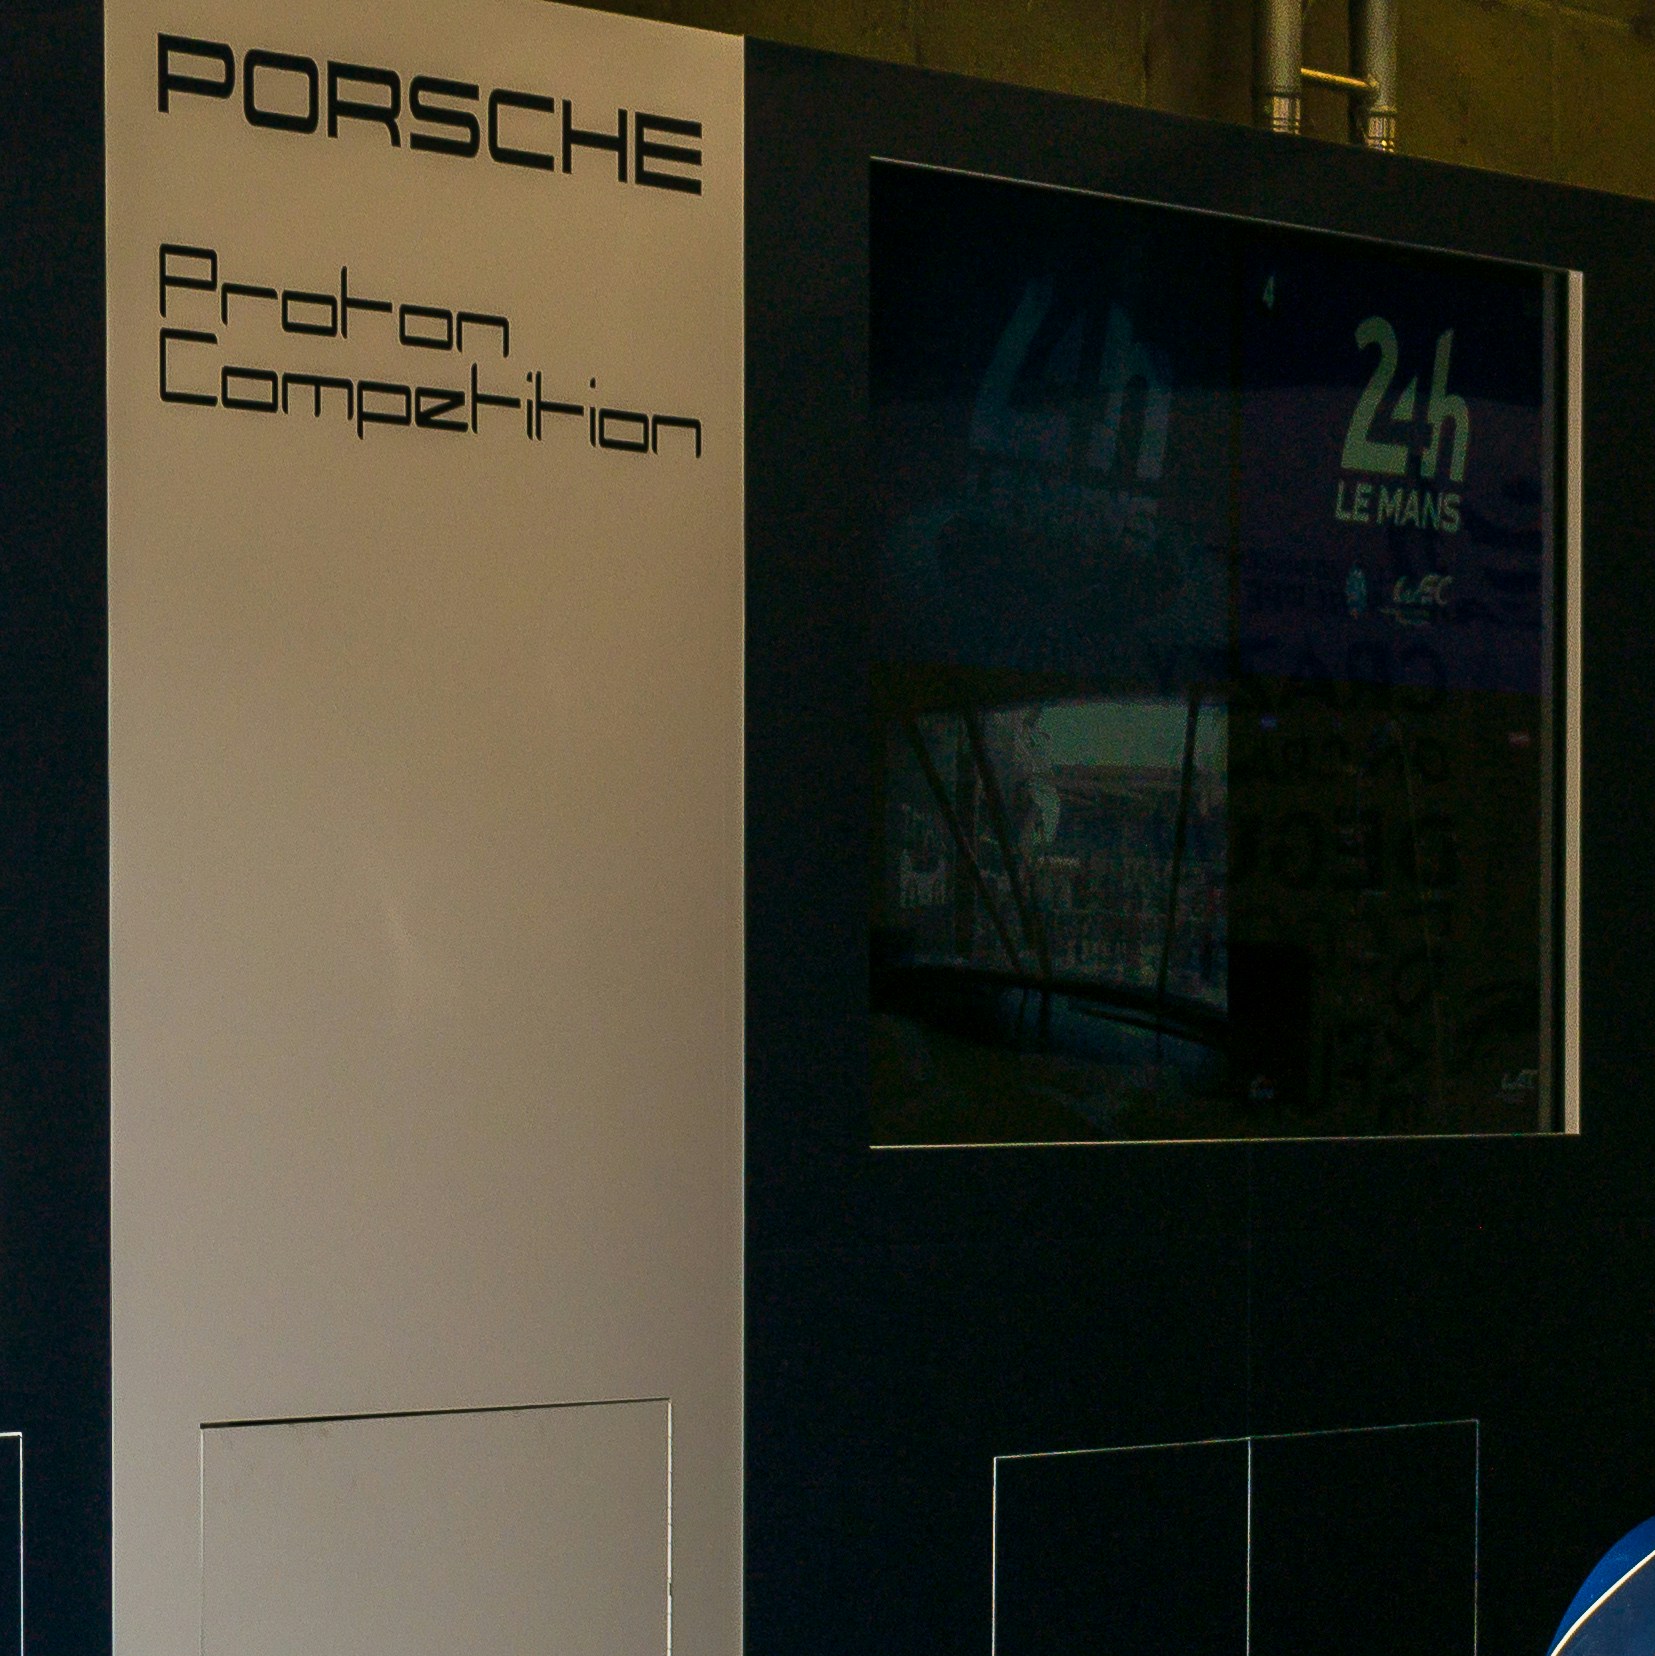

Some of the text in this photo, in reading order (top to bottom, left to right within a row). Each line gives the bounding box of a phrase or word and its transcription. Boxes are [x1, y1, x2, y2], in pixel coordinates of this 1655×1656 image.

[158, 33, 702, 195] PORSCHE
[159, 243, 510, 358] Proton
[159, 328, 702, 459] Competition
[1335, 481, 1462, 535] LE MANS
